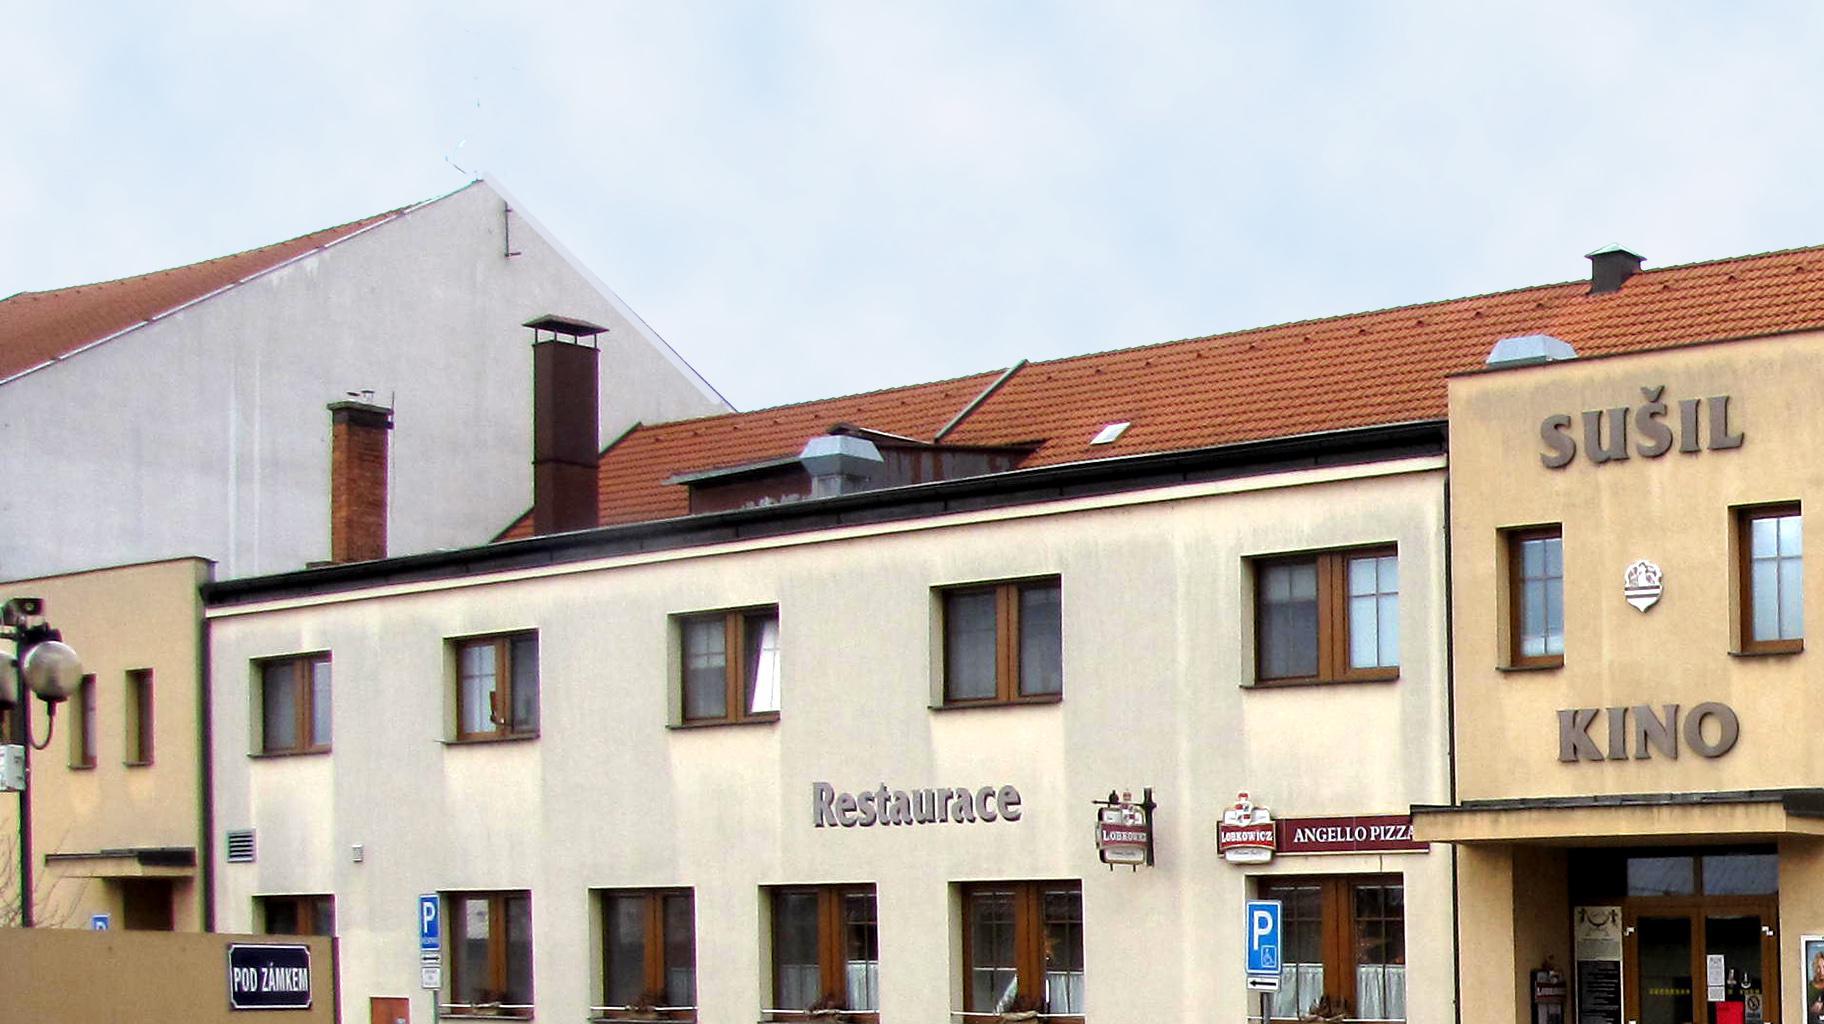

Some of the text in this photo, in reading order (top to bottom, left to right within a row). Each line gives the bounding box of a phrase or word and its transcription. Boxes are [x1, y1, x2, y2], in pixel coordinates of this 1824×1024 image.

[1539, 384, 1745, 469] SUŠIL
[1556, 701, 1740, 763] KINO
[812, 781, 1022, 828] Restaurace
[1221, 830, 1273, 843] LOBKOWICZ
[1294, 826, 1367, 843] ANGELLO
[422, 901, 436, 933] P
[1253, 910, 1273, 951] P
[233, 961, 309, 992] POD ZÁMKEM
